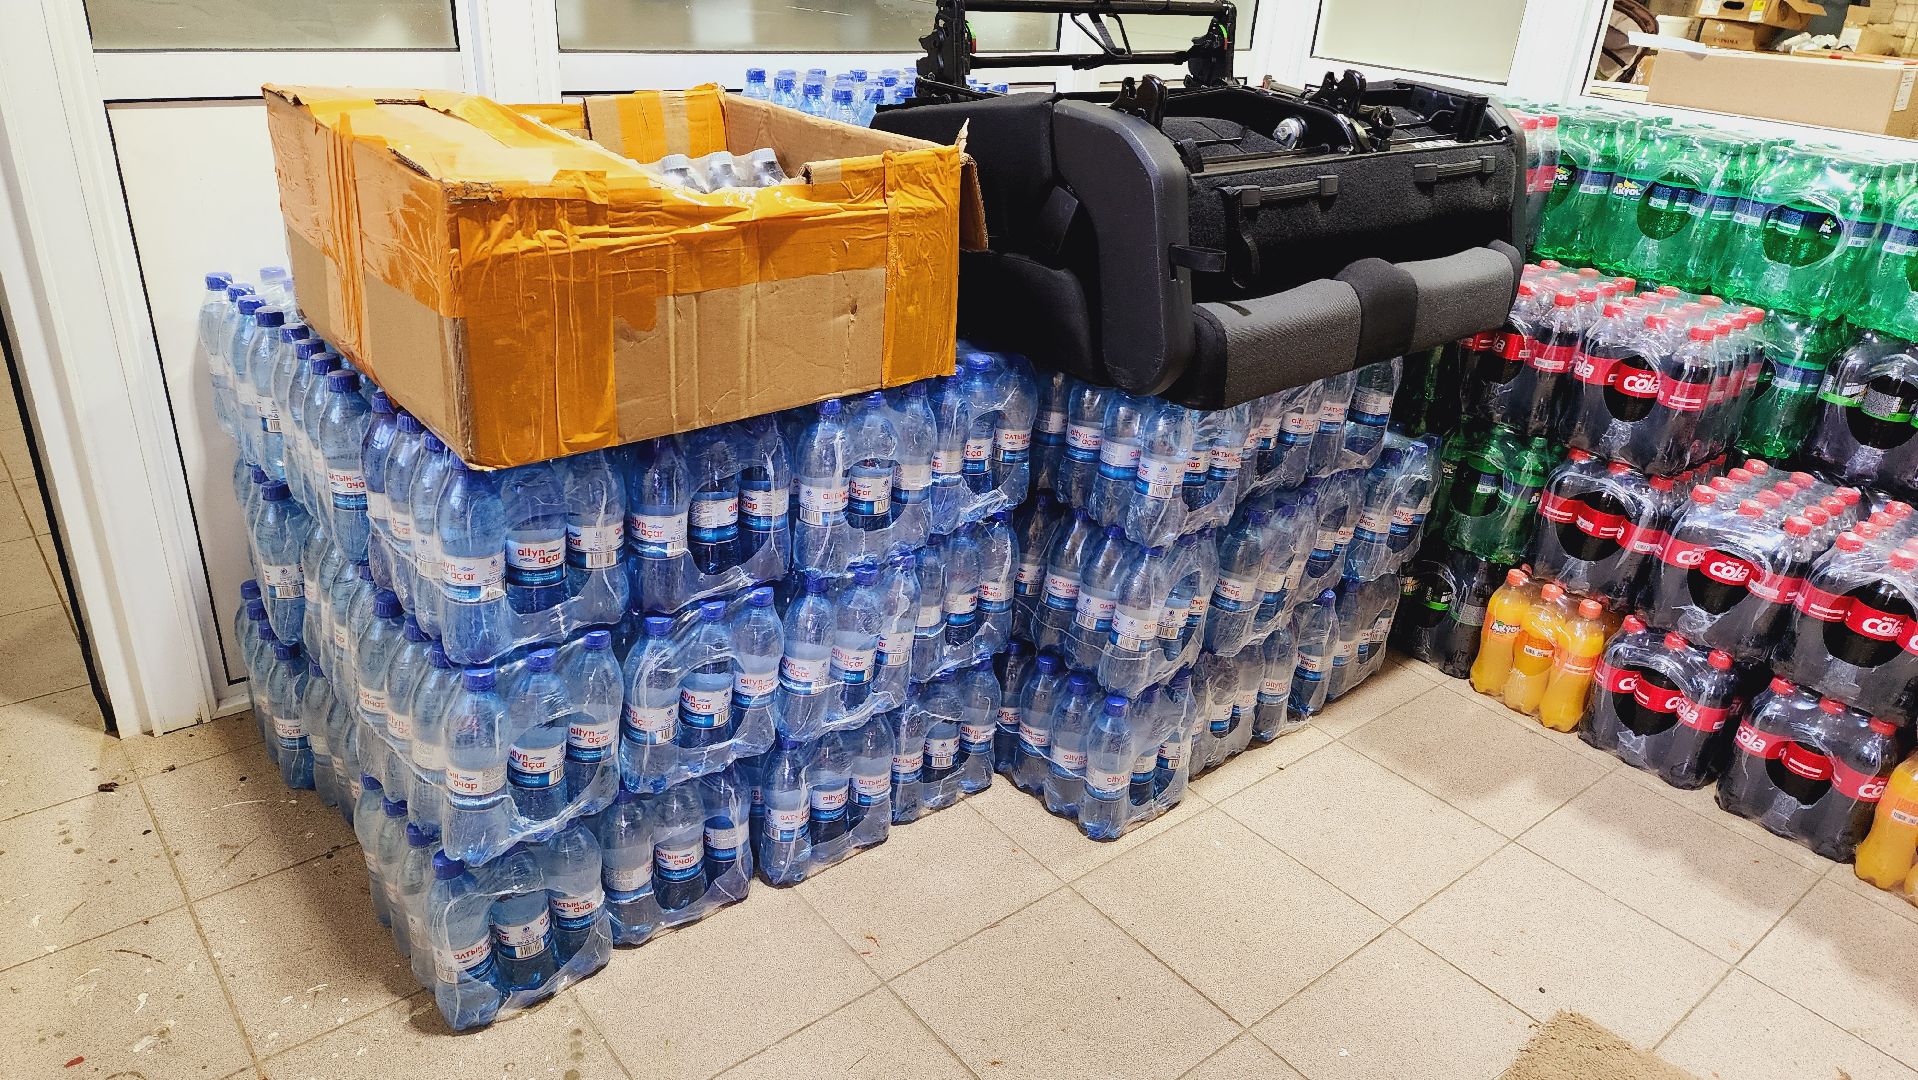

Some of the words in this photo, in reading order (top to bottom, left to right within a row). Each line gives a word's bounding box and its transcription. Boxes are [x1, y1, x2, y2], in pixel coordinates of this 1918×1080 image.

[1624, 376, 1660, 393] Cola
[641, 530, 663, 538] açar
[518, 548, 545, 558] altyn
[538, 552, 560, 564] açar
[1710, 562, 1749, 581] Cola
[450, 572, 475, 582] açar
[740, 678, 763, 686] altyn
[690, 702, 712, 710] açar
[570, 726, 595, 737] altyn
[522, 761, 546, 769] açar
[454, 779, 478, 791] ачар
[553, 900, 579, 908] алтын
[454, 946, 482, 960] алтын
